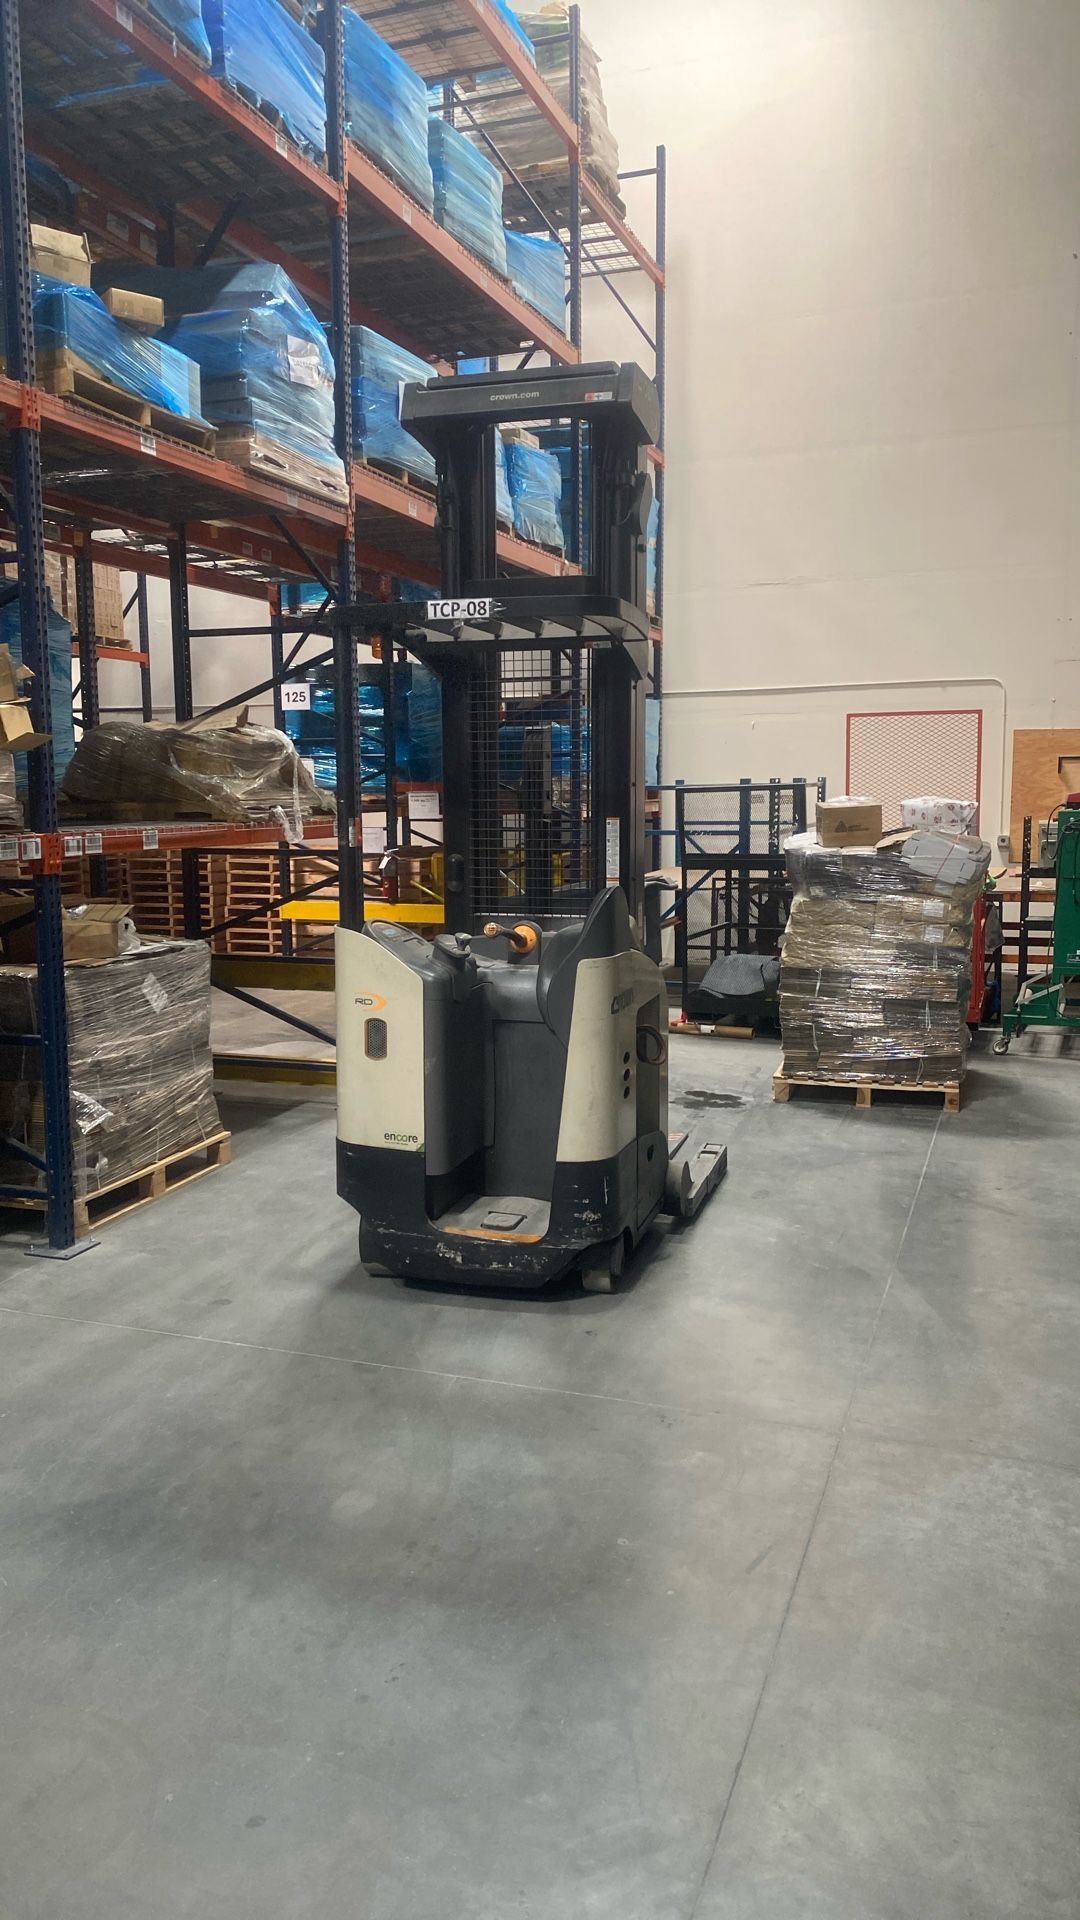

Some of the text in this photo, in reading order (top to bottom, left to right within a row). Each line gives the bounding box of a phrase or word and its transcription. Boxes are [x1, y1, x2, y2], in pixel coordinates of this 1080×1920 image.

[490, 391, 539, 401] crown.com
[430, 601, 487, 618] TCP-08
[285, 692, 306, 702] 125
[384, 1132, 418, 1143] encore
